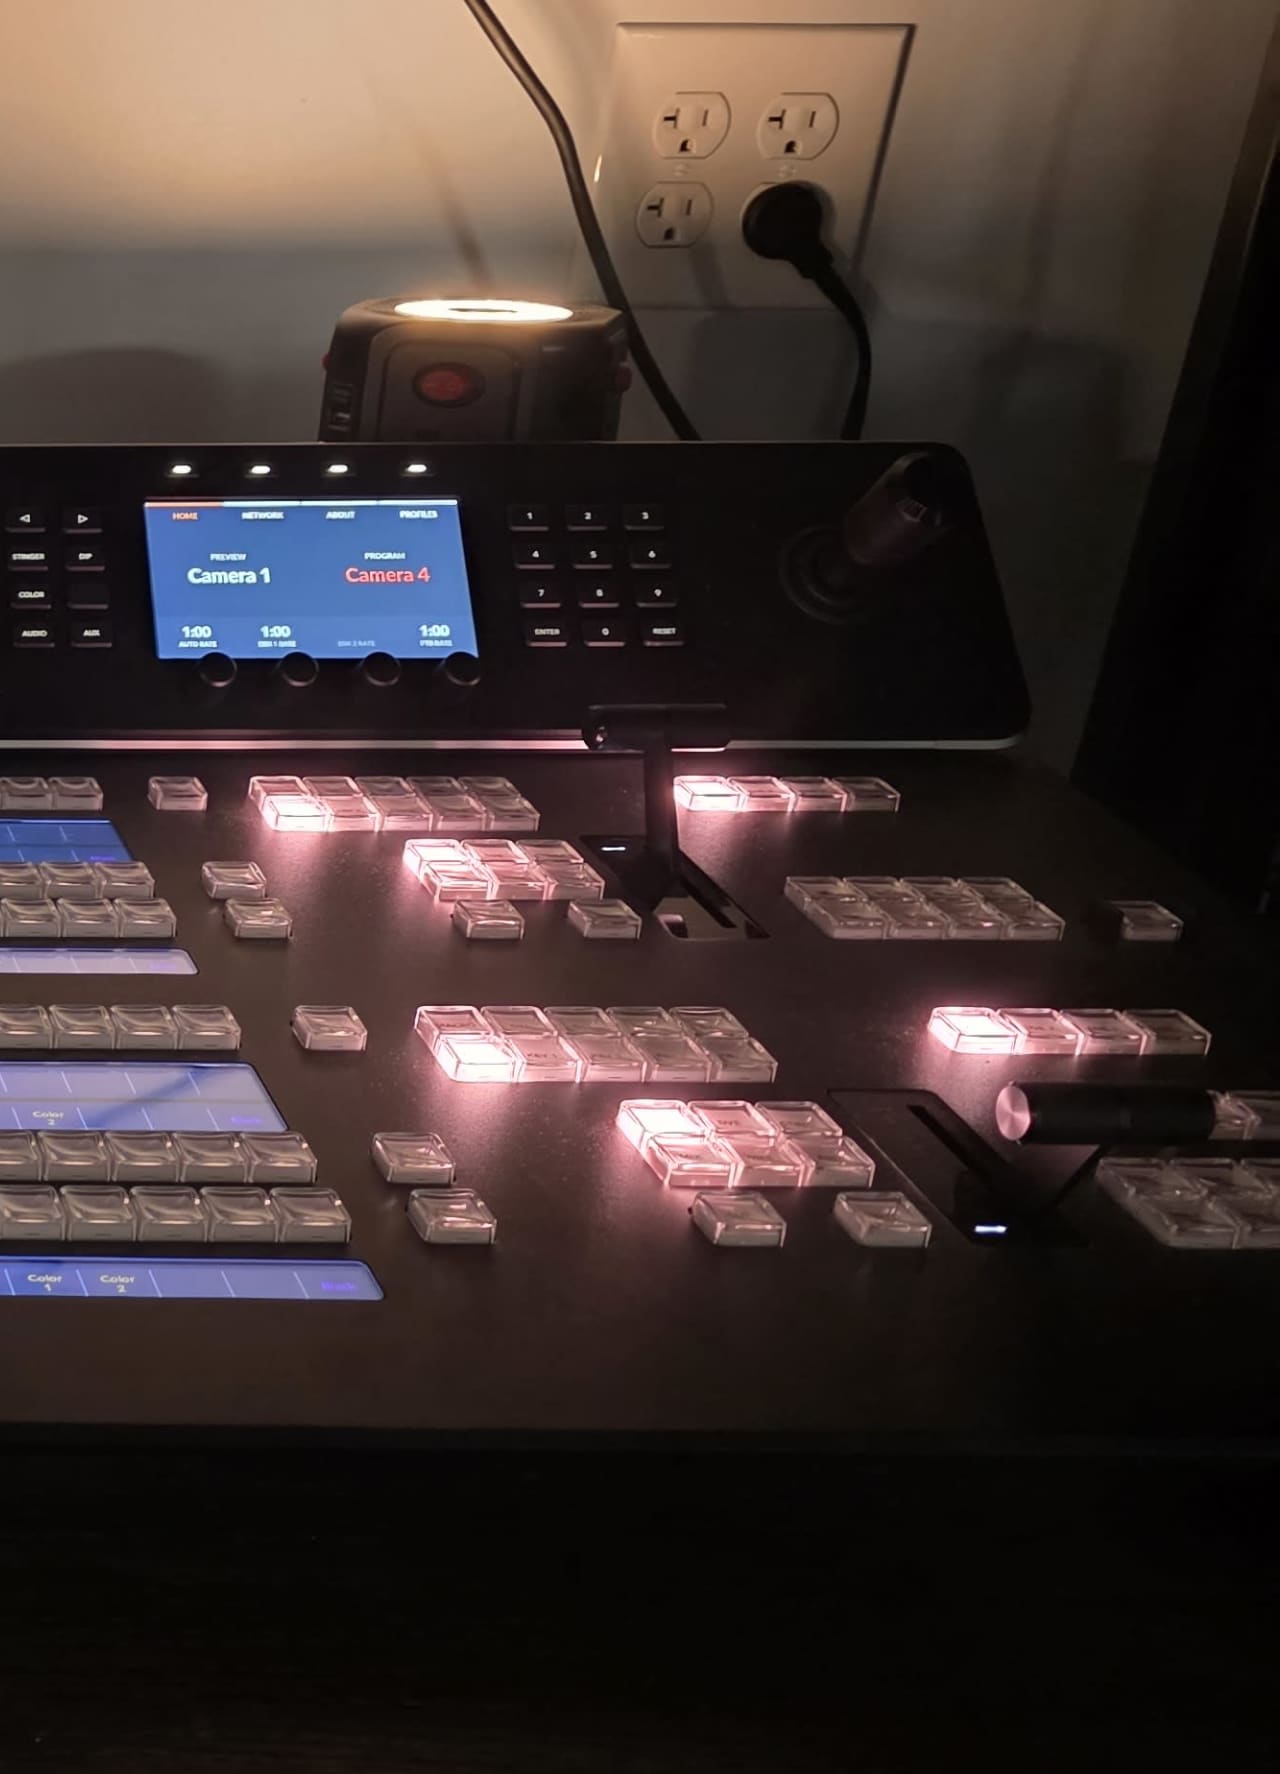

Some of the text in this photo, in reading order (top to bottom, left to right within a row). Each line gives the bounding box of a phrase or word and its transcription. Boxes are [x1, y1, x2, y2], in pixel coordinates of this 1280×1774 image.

[527, 512, 533, 520] 1
[584, 512, 592, 520] 2
[642, 512, 649, 520] 3
[532, 550, 540, 558] 4
[590, 551, 598, 559] 5
[648, 550, 656, 558] 6
[187, 568, 271, 585] Camera 1
[345, 567, 431, 583] Camera 4
[538, 589, 545, 597] 7
[654, 588, 662, 597] 9
[182, 626, 212, 639] 1:00
[260, 626, 291, 639] 1:00
[419, 624, 450, 638] 1:00
[601, 628, 610, 636] 0
[28, 1274, 62, 1284] Color
[100, 1275, 135, 1284] Color
[44, 1284, 51, 1292] 1
[116, 1285, 126, 1293] 2
